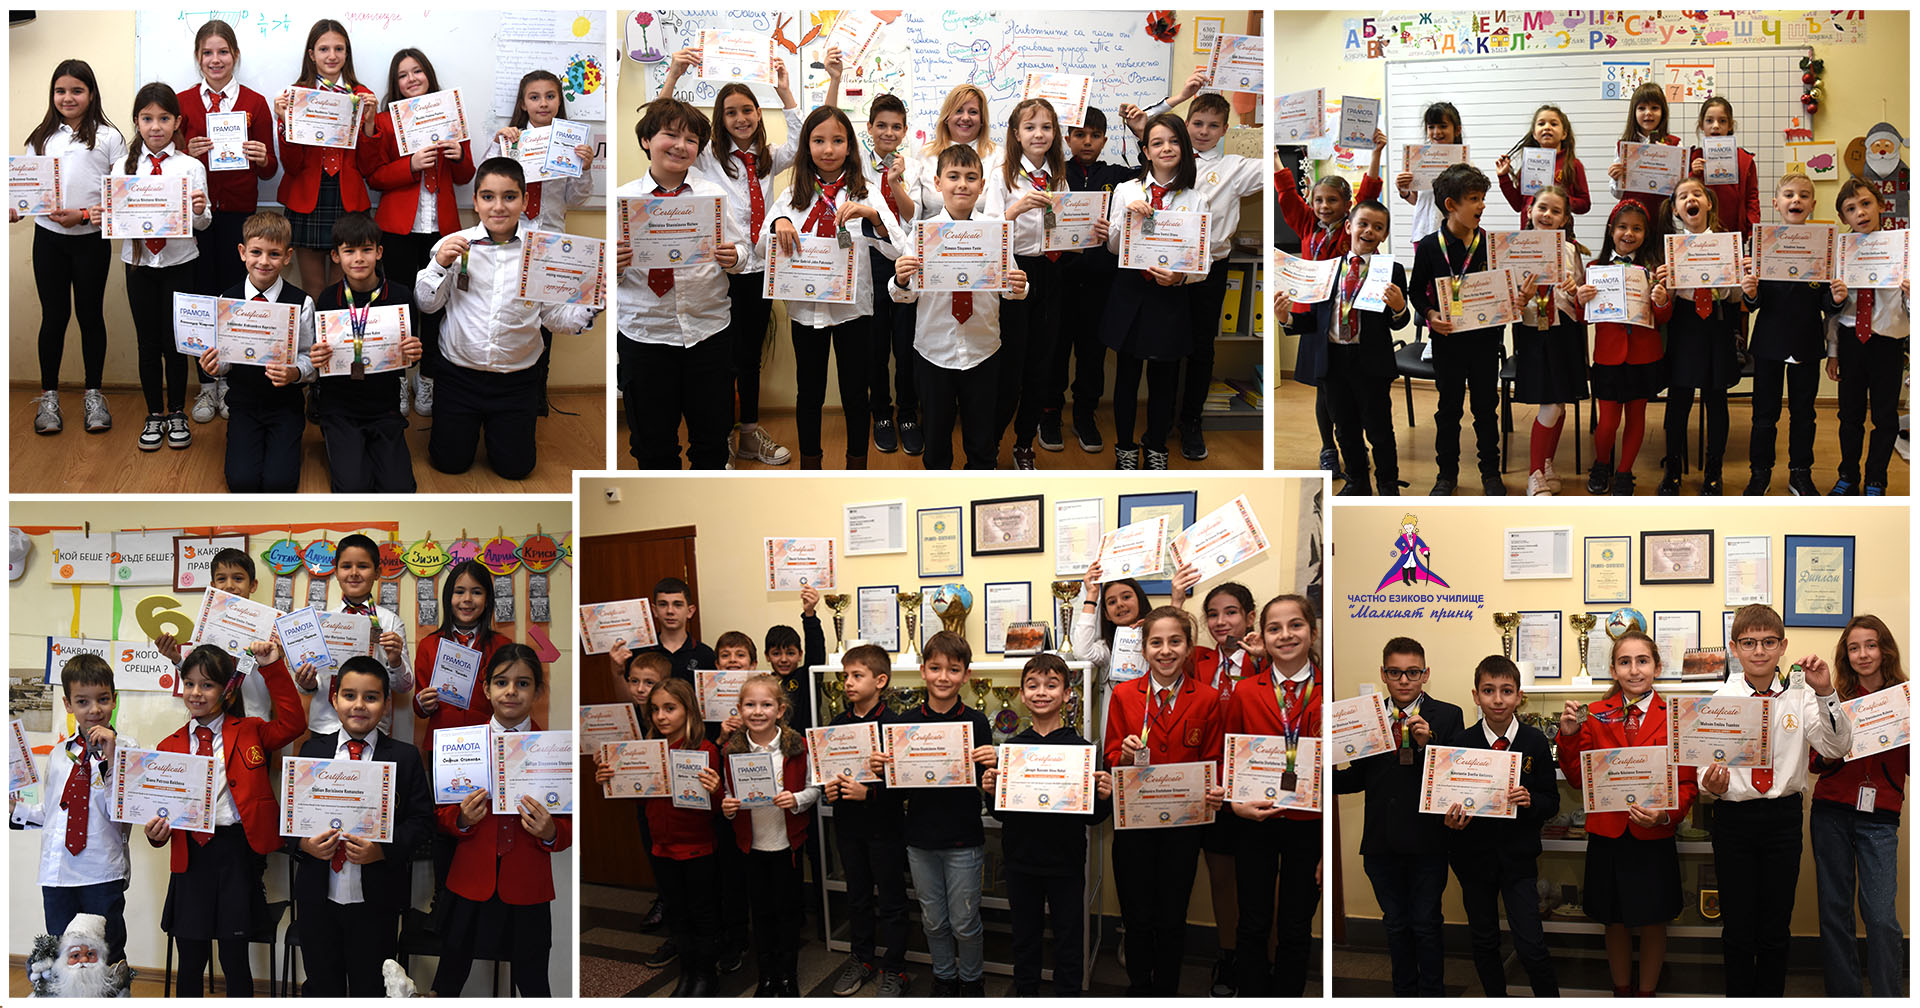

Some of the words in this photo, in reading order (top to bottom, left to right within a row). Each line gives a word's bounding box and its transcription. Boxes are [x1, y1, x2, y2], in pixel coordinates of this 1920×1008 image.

[1419, 12, 1432, 25] Ж
[1480, 16, 1490, 33] Е
[1523, 11, 1544, 31] М
[1363, 18, 1376, 38] Б
[1734, 21, 1753, 37] Ш
[1762, 20, 1781, 44] Ч
[1345, 29, 1361, 49] А
[1441, 34, 1456, 54] Д
[1476, 37, 1490, 54] К
[1510, 33, 1525, 50] Л
[1589, 31, 1603, 50] Р
[1607, 66, 1616, 81] 8
[1671, 68, 1680, 84] 7
[1606, 83, 1616, 97] 8
[1670, 85, 1681, 100] 7
[213, 125, 241, 133] ГРАМОТА
[556, 130, 582, 142] ГРАМОТА
[652, 207, 692, 218] Certificate
[945, 231, 981, 241] Certificate
[1512, 238, 1540, 247] Certificate
[1780, 232, 1811, 242] Certificate
[1689, 239, 1719, 249] Certificate
[179, 307, 211, 318] ГРАМОТА
[234, 305, 270, 319] Certificate
[52, 548, 60, 563] 1
[60, 551, 78, 562] КОЙ
[79, 552, 104, 562] БЕШЕ
[105, 552, 110, 561] ?
[111, 552, 123, 564] 2
[121, 553, 144, 563] КЪДЕ
[145, 552, 175, 562] БЕШЕ?
[184, 546, 196, 559] 3
[187, 561, 212, 571] ПРАВ
[1798, 569, 1841, 584] Диплом
[230, 603, 258, 618] Certificate
[135, 594, 196, 645] 6
[284, 622, 314, 637] ГРАМОТА
[322, 621, 353, 632] Certificate
[51, 643, 61, 656] 4
[90, 647, 104, 657] ИМ
[121, 649, 134, 662] 5
[135, 650, 159, 660] КОГО
[443, 653, 472, 670] ГРАМОТА
[125, 664, 162, 674] СРЕЩНА
[164, 665, 169, 673] ?
[1701, 705, 1740, 717] Certificate
[1857, 699, 1888, 713] Certificate
[911, 731, 944, 743] Certificate
[442, 742, 481, 752] ГРАМОТА
[147, 761, 185, 774] Certificate
[1455, 755, 1490, 767] Certificate
[1612, 755, 1647, 767] Certificate
[318, 770, 360, 783] Certificate
[738, 766, 768, 774] ГРАМОТА
[1144, 773, 1183, 785] Certificate
